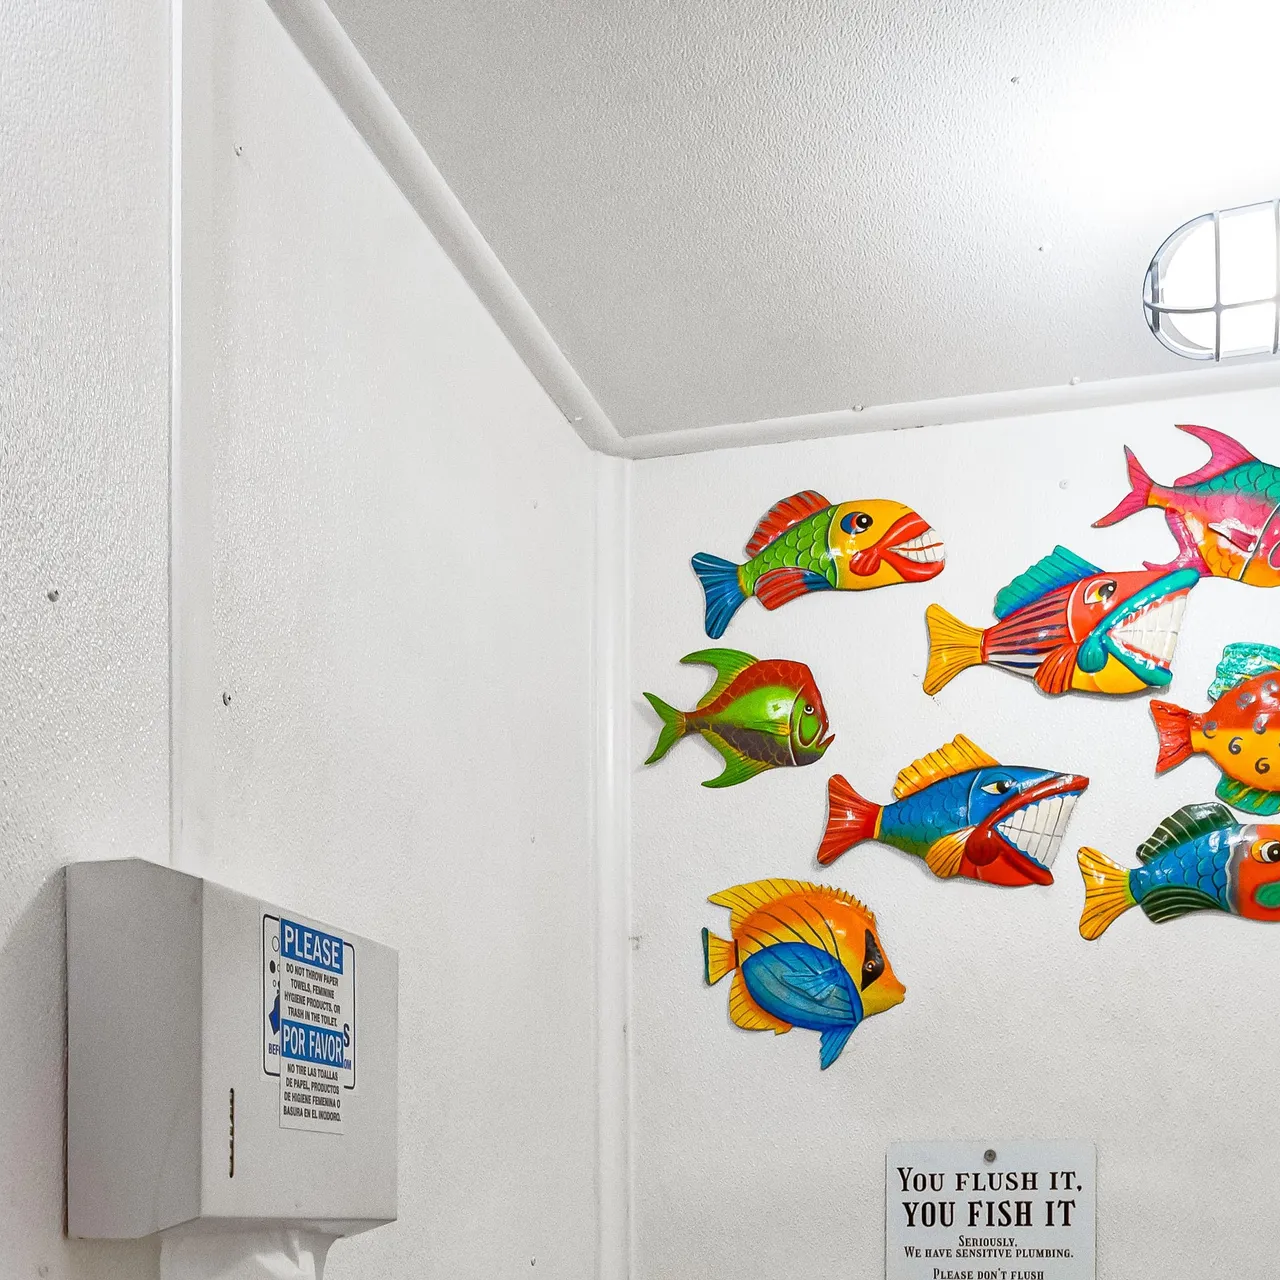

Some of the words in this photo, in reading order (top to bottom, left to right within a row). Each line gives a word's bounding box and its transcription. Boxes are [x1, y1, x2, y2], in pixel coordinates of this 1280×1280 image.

[284, 925, 340, 969] PLEASE
[286, 963, 294, 973] DO
[295, 965, 305, 976] NOT
[306, 968, 323, 981] THROW
[324, 973, 339, 986] PAPER
[291, 979, 311, 994] TOWELS,
[313, 985, 334, 999] FEMININE
[284, 991, 305, 1005] HYGIENE
[307, 997, 333, 1012] PRODUCTS,
[334, 1004, 340, 1014] OR
[288, 1006, 304, 1018] TRASH
[305, 1010, 310, 1020] IN
[311, 1011, 320, 1023] THE
[321, 1014, 338, 1027] TOILET.
[283, 1024, 305, 1056] POR
[310, 1030, 342, 1063] FAVOR
[287, 1063, 295, 1073] NO
[296, 1065, 306, 1076] TIRE
[308, 1067, 316, 1077] LAS
[318, 1069, 338, 1081] TOALLAS
[286, 1077, 293, 1087] DE
[294, 1079, 310, 1091] PAPEL,
[311, 1082, 339, 1095] PRODUCTOS
[284, 1091, 291, 1101] DE
[292, 1093, 311, 1104] HIGIENE
[312, 1096, 336, 1108] FEMENINA
[283, 1105, 303, 1117] BASURA
[304, 1108, 311, 1118] EN
[312, 1109, 317, 1119] EL
[897, 1167, 945, 1192] YOU
[955, 1171, 1038, 1191] FLUSH
[1049, 1171, 1083, 1192] IT,
[902, 1201, 956, 1228] YOU
[967, 1199, 1033, 1227] FISH
[1045, 1199, 1076, 1227] IT
[904, 1245, 921, 1258] WE
[925, 1248, 952, 1258] HAVE
[956, 1248, 1012, 1258] SENSITIVE
[1016, 1248, 1074, 1258] PLUMBING.
[933, 1268, 973, 1280] PLEASE
[977, 1268, 1007, 1280] DON'T
[1010, 1271, 1044, 1280] FLUSH
